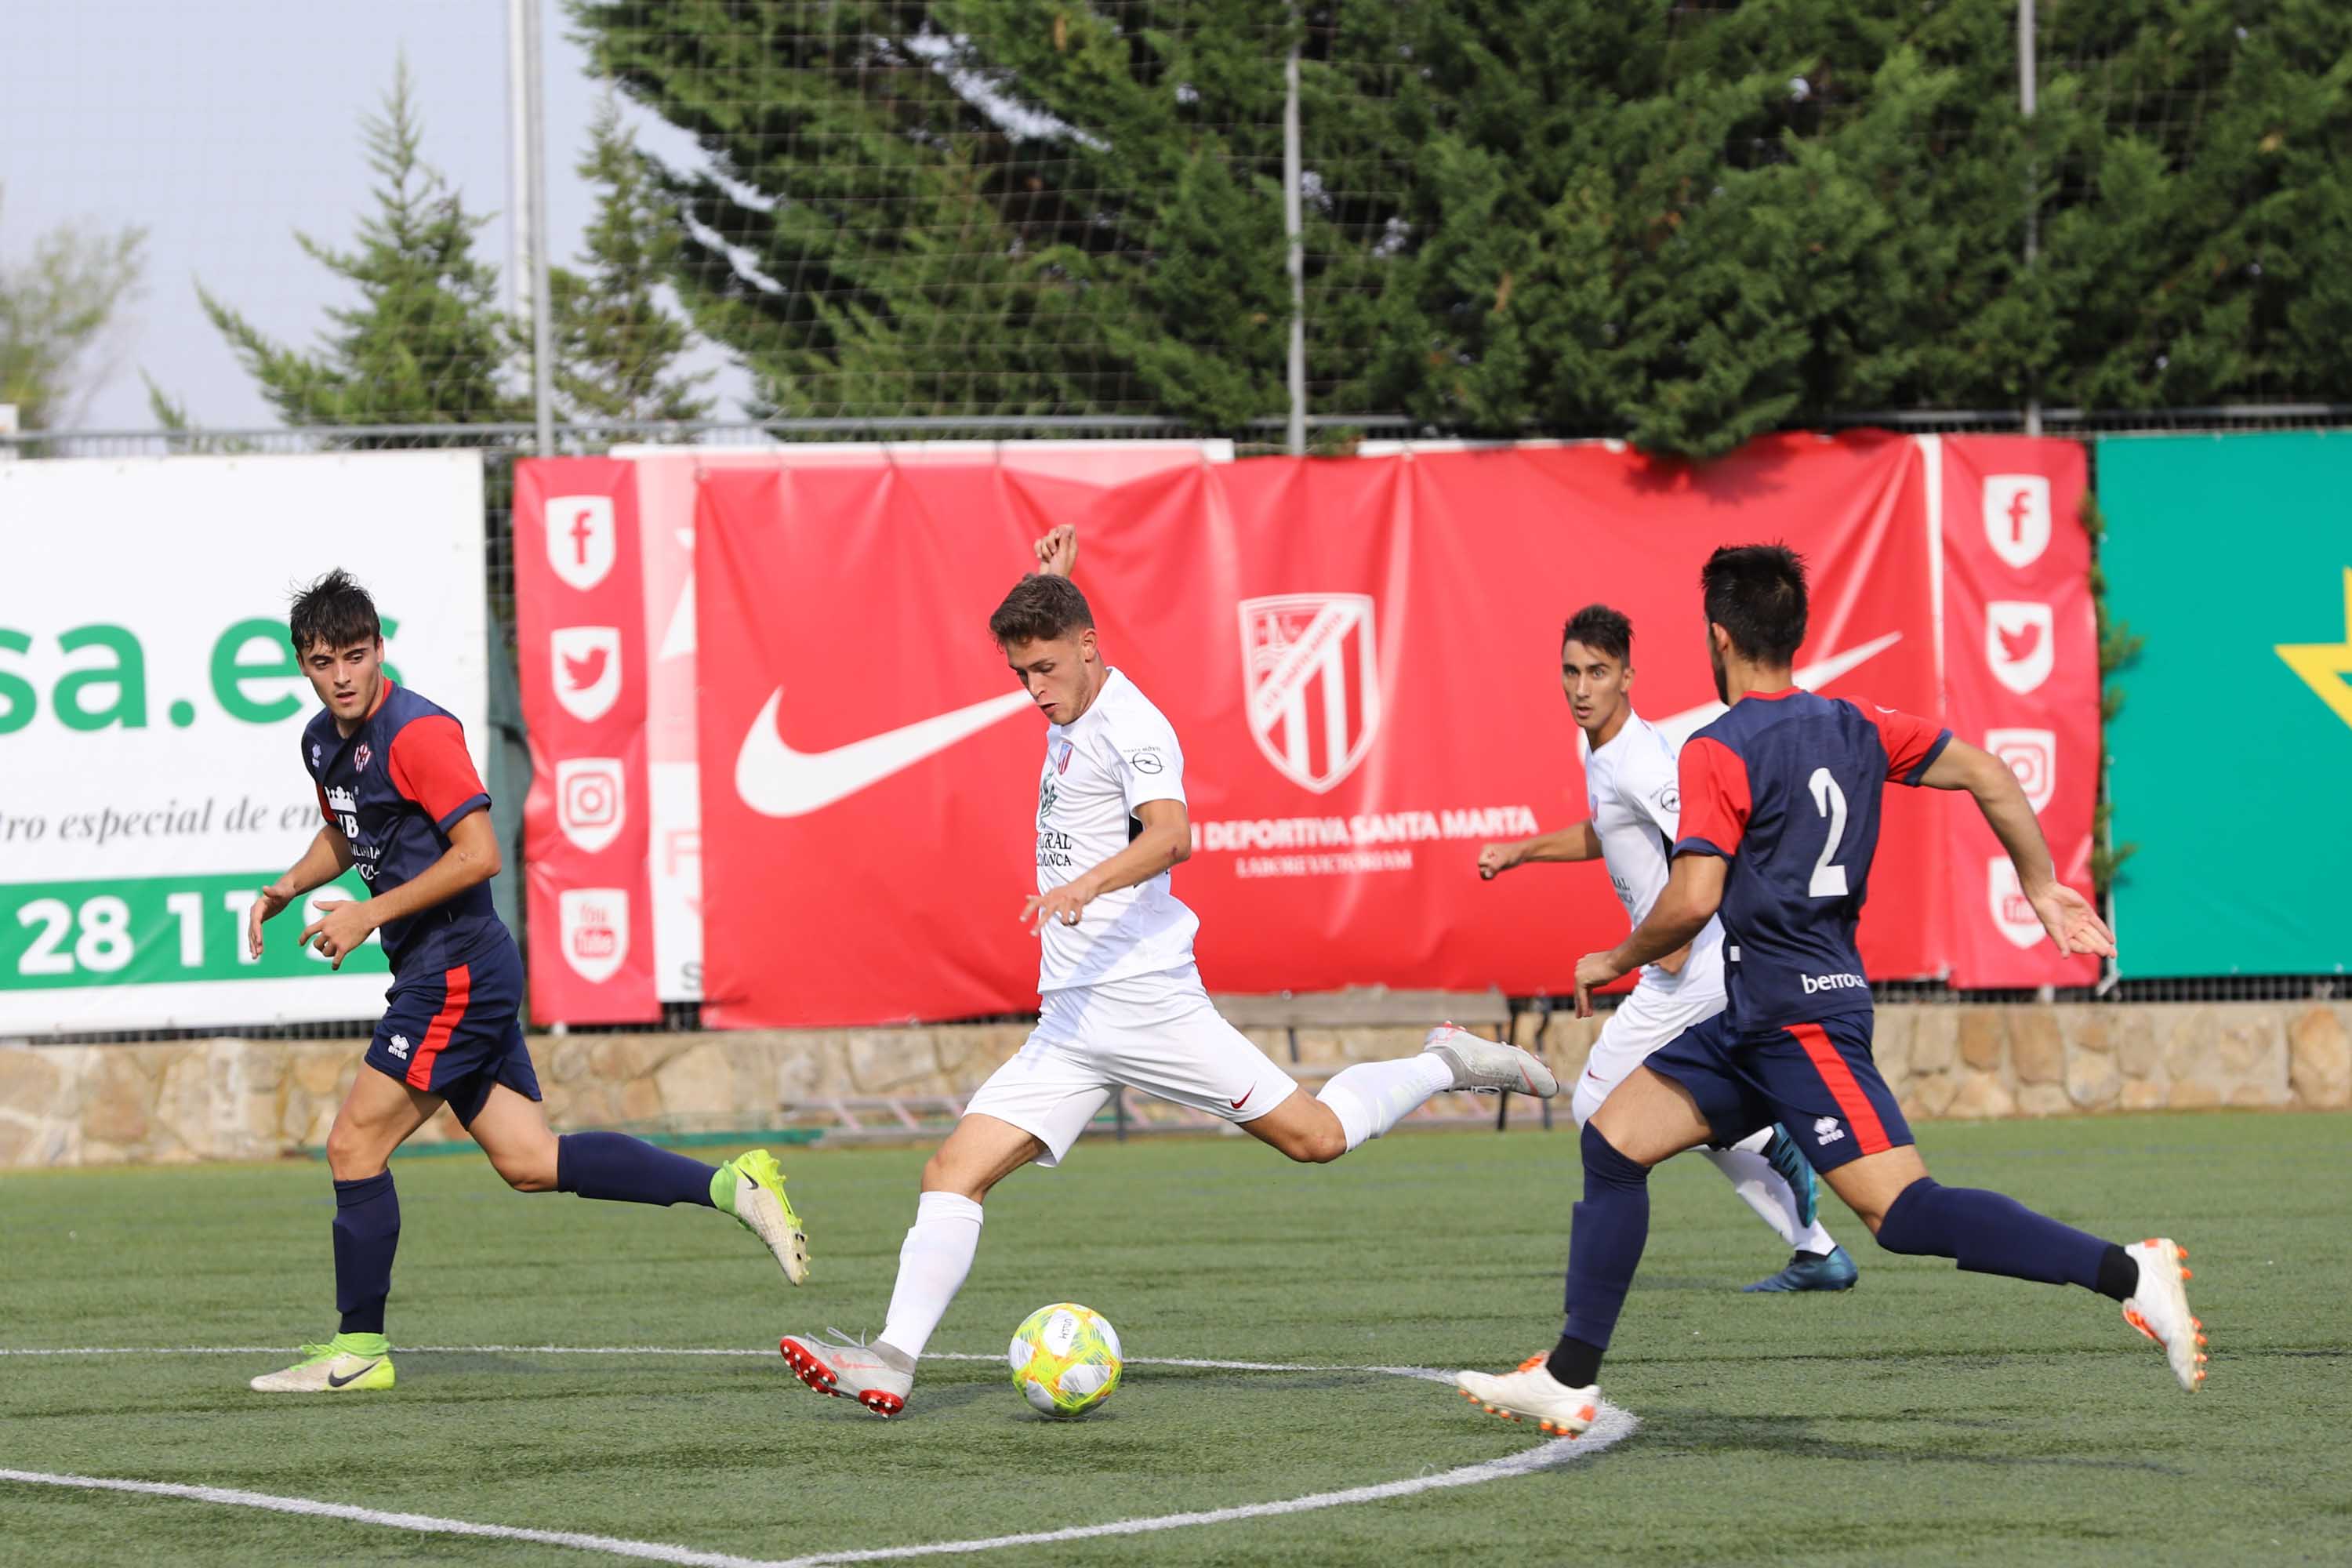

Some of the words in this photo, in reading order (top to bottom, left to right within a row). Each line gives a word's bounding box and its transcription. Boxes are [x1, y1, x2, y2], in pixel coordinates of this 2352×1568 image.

[0, 615, 405, 735] sa.e
[0, 811, 46, 842] ro
[59, 797, 216, 845] especial
[223, 796, 269, 833] de
[1205, 817, 1349, 851] DEPORTIVA
[1350, 810, 1440, 845] SANTA
[1440, 806, 1539, 840] MARTA
[1808, 768, 1849, 898] 2
[16, 895, 135, 975] 28
